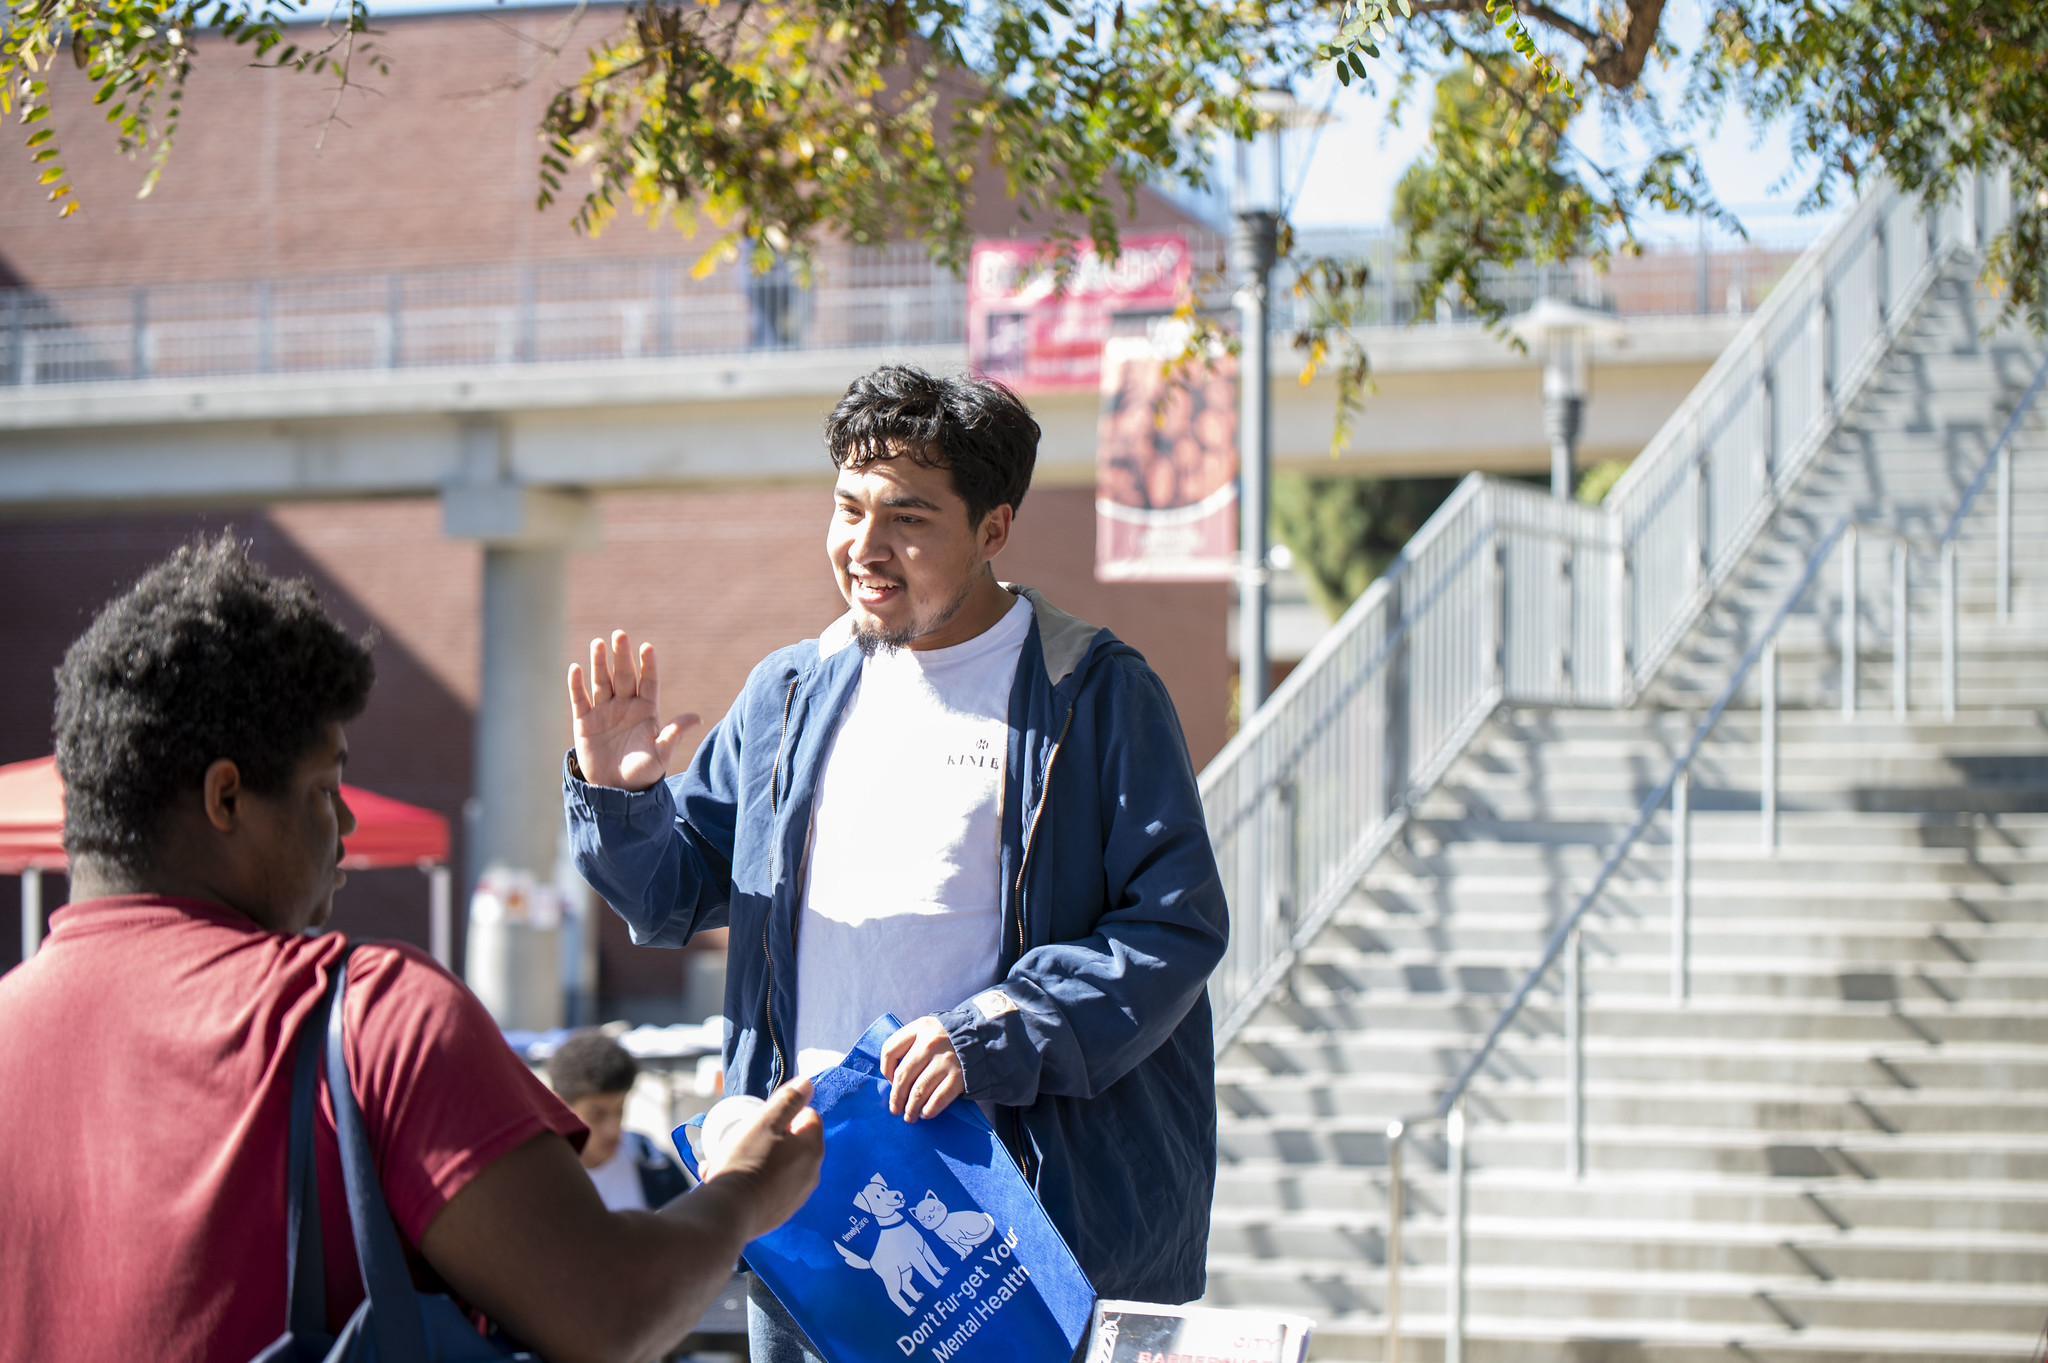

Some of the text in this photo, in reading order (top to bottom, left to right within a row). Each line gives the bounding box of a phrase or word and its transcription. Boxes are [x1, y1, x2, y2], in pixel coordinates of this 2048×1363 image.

[841, 1217, 869, 1242] timelycare
[896, 1226, 1019, 1356] Don't Fur-get Your
[931, 1265, 1030, 1363] Mental Health
